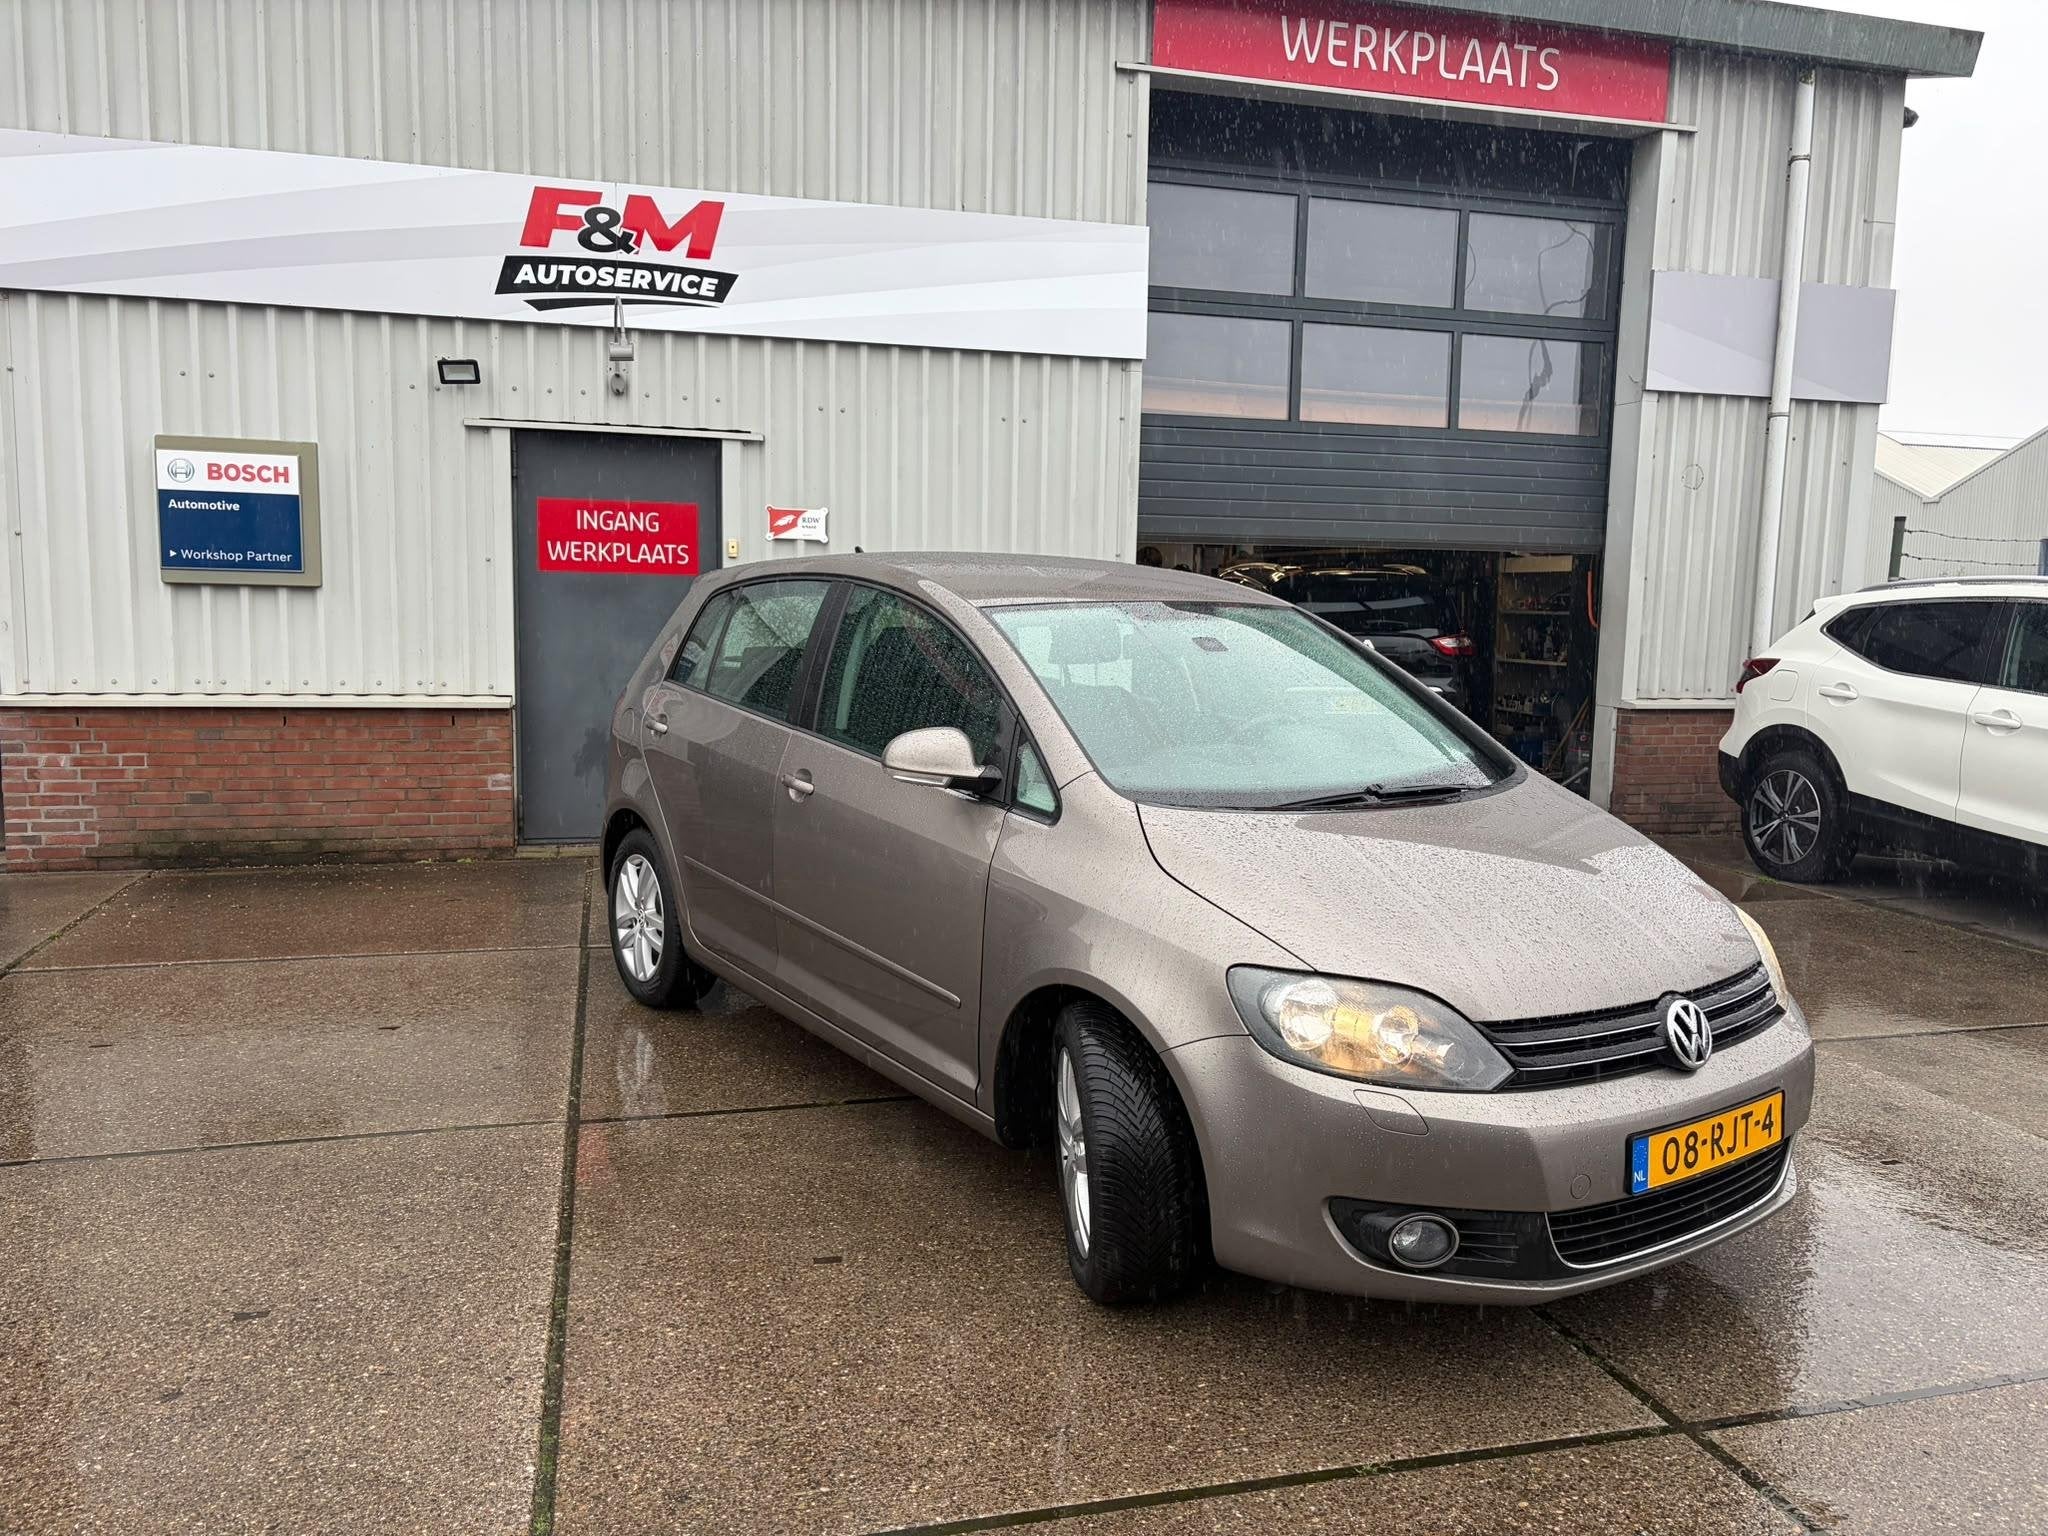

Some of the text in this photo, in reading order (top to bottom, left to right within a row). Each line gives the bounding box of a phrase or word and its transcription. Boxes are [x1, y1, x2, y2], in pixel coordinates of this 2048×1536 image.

[1281, 15, 1560, 91] WERKPLAATS
[519, 185, 726, 260] F&M
[513, 263, 719, 298] AUTOSERVICE
[206, 462, 290, 484] BOSCH
[168, 498, 241, 511] Automotive
[576, 509, 660, 533] INGANG
[180, 549, 293, 563] Workshop Partner
[546, 540, 690, 565] WERKPLAATS
[1662, 1102, 1775, 1176] 08-RJT-4
[1633, 1170, 1647, 1182] NL
